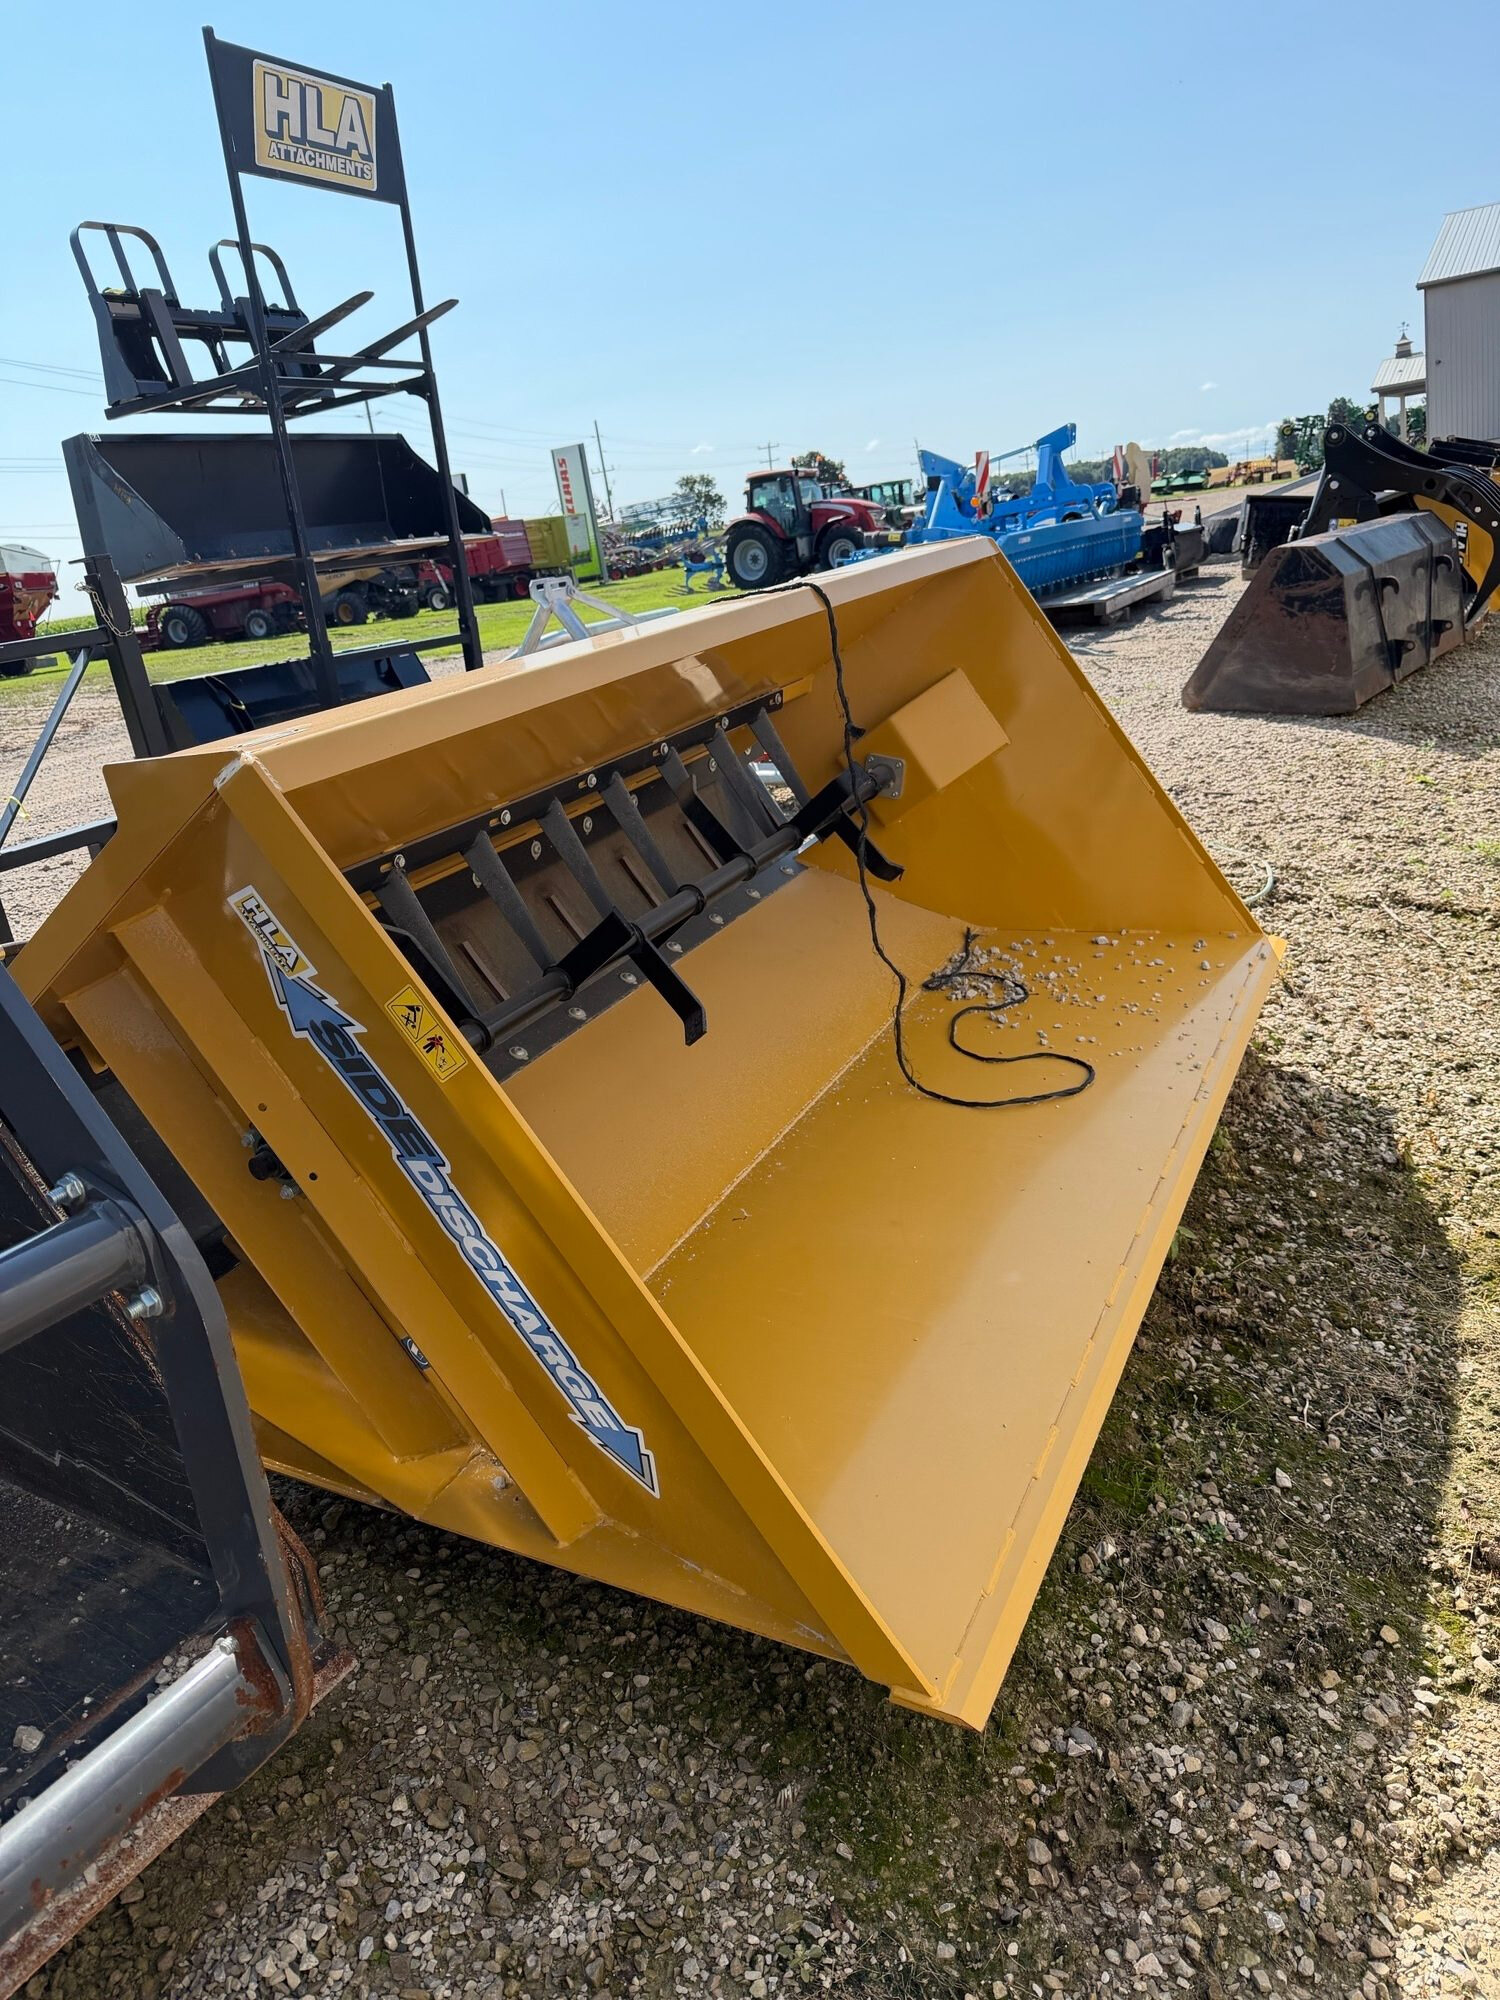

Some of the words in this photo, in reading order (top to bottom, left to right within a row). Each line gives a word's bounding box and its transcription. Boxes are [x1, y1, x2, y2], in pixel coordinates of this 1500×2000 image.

[264, 72, 373, 162] HLA
[268, 141, 373, 180] ATTACHMENTS
[557, 458, 576, 514] CLAAS
[237, 904, 291, 974] ATTACHMENTS
[241, 896, 299, 972] HLA
[309, 1019, 438, 1158] SIDE
[403, 1159, 619, 1432] DISCHARGE
